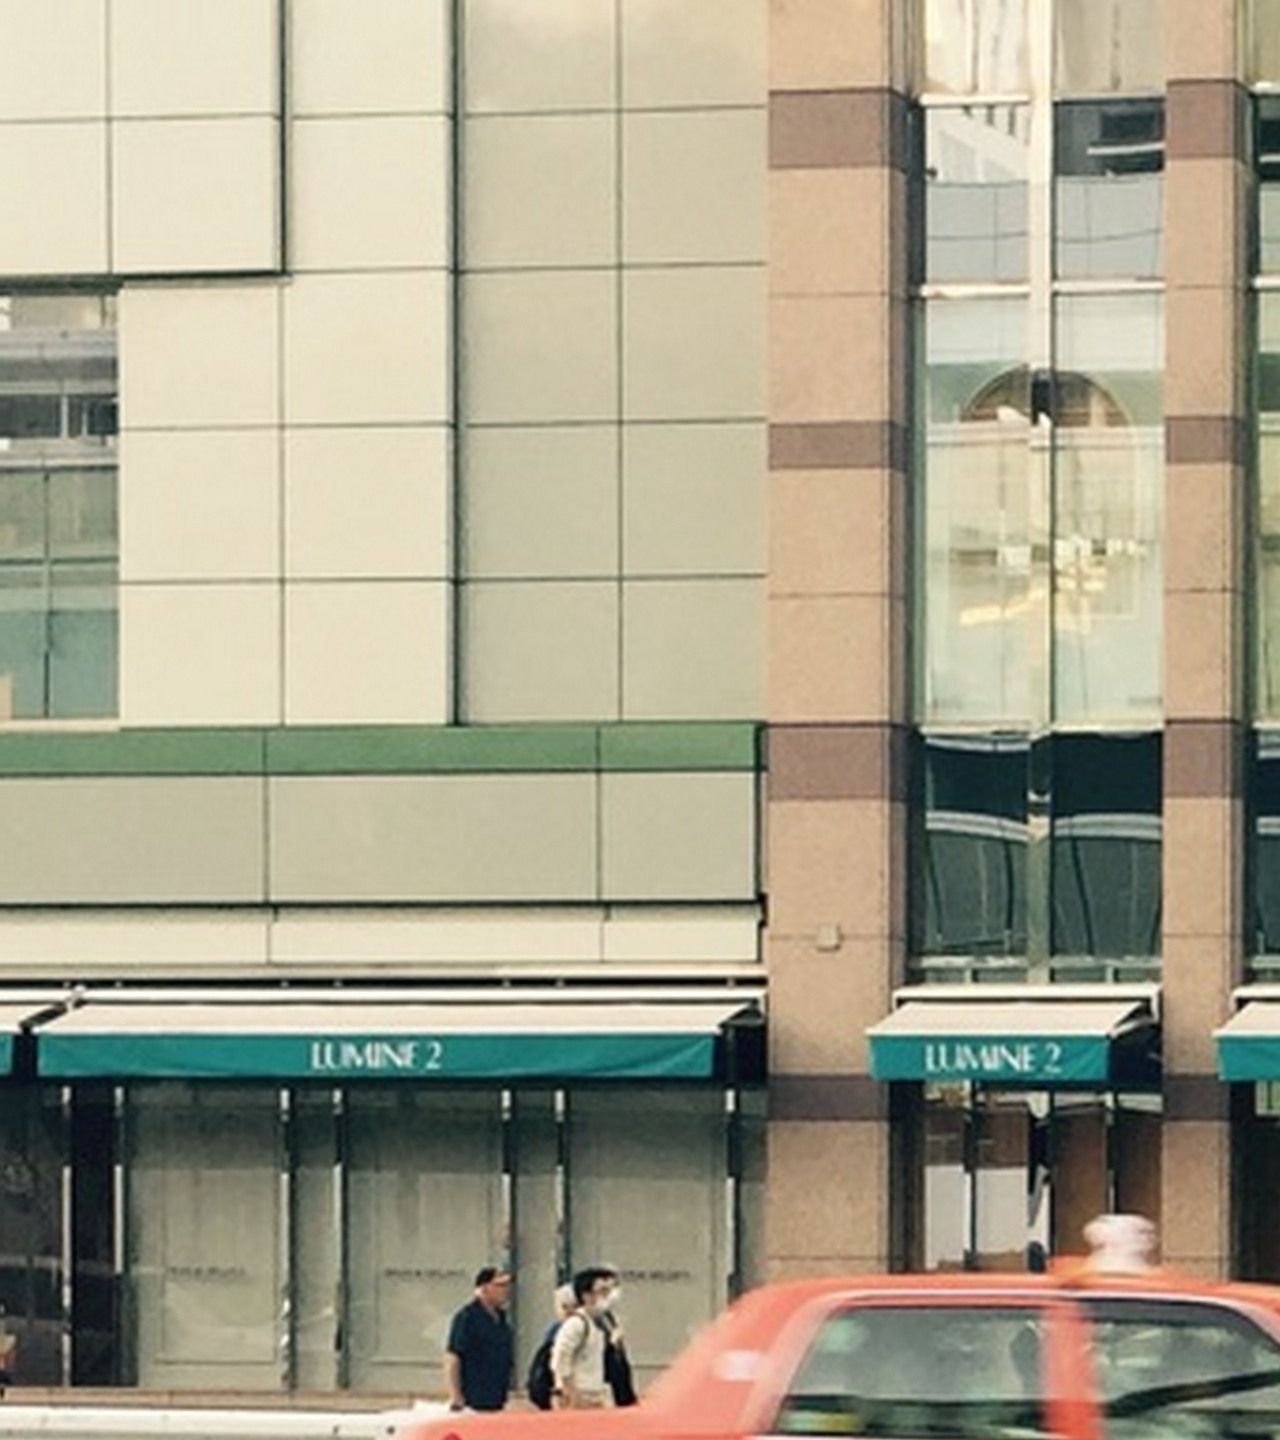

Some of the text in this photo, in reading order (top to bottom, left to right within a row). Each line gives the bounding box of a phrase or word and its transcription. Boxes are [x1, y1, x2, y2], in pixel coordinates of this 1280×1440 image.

[312, 1041, 443, 1070] LUMINE 2
[925, 1042, 1063, 1073] LUMINE 2
